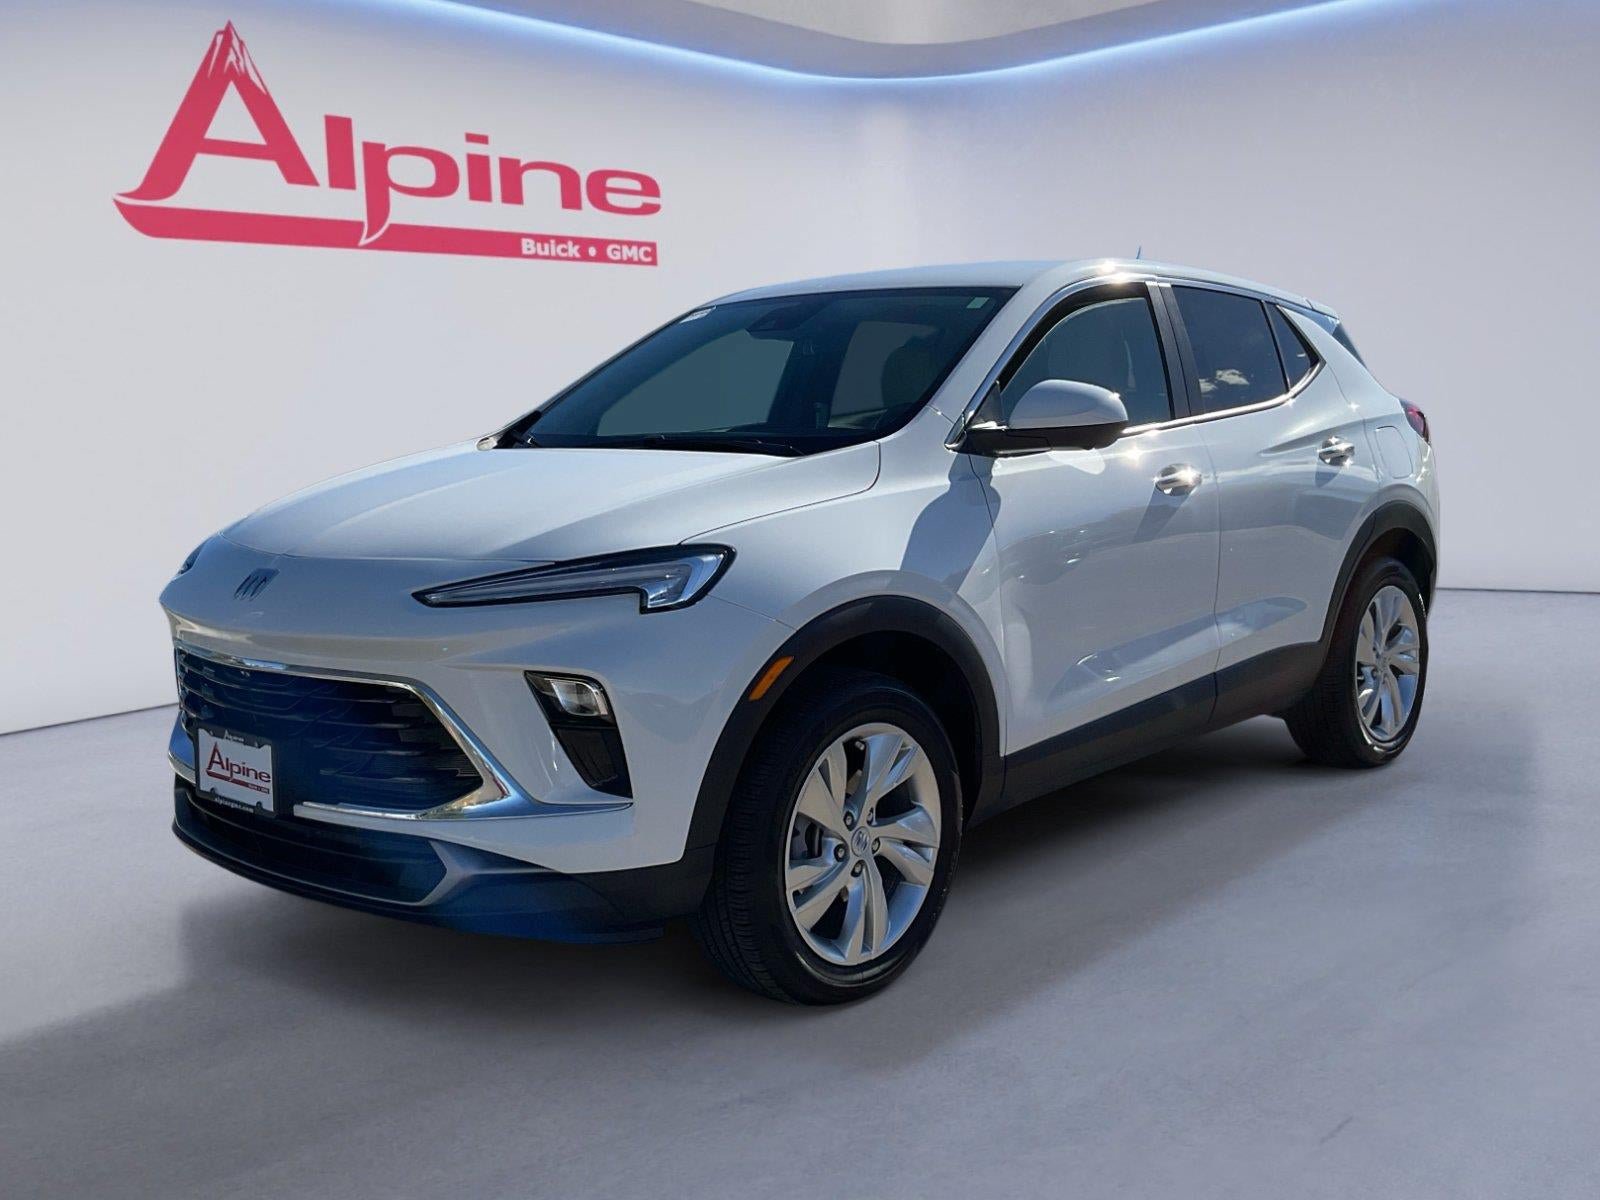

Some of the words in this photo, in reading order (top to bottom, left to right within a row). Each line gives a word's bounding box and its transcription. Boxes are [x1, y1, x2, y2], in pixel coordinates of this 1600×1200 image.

[113, 20, 662, 246] Alpine
[520, 237, 581, 258] Buick
[606, 243, 653, 262] GMC
[206, 741, 271, 783] Alpine
